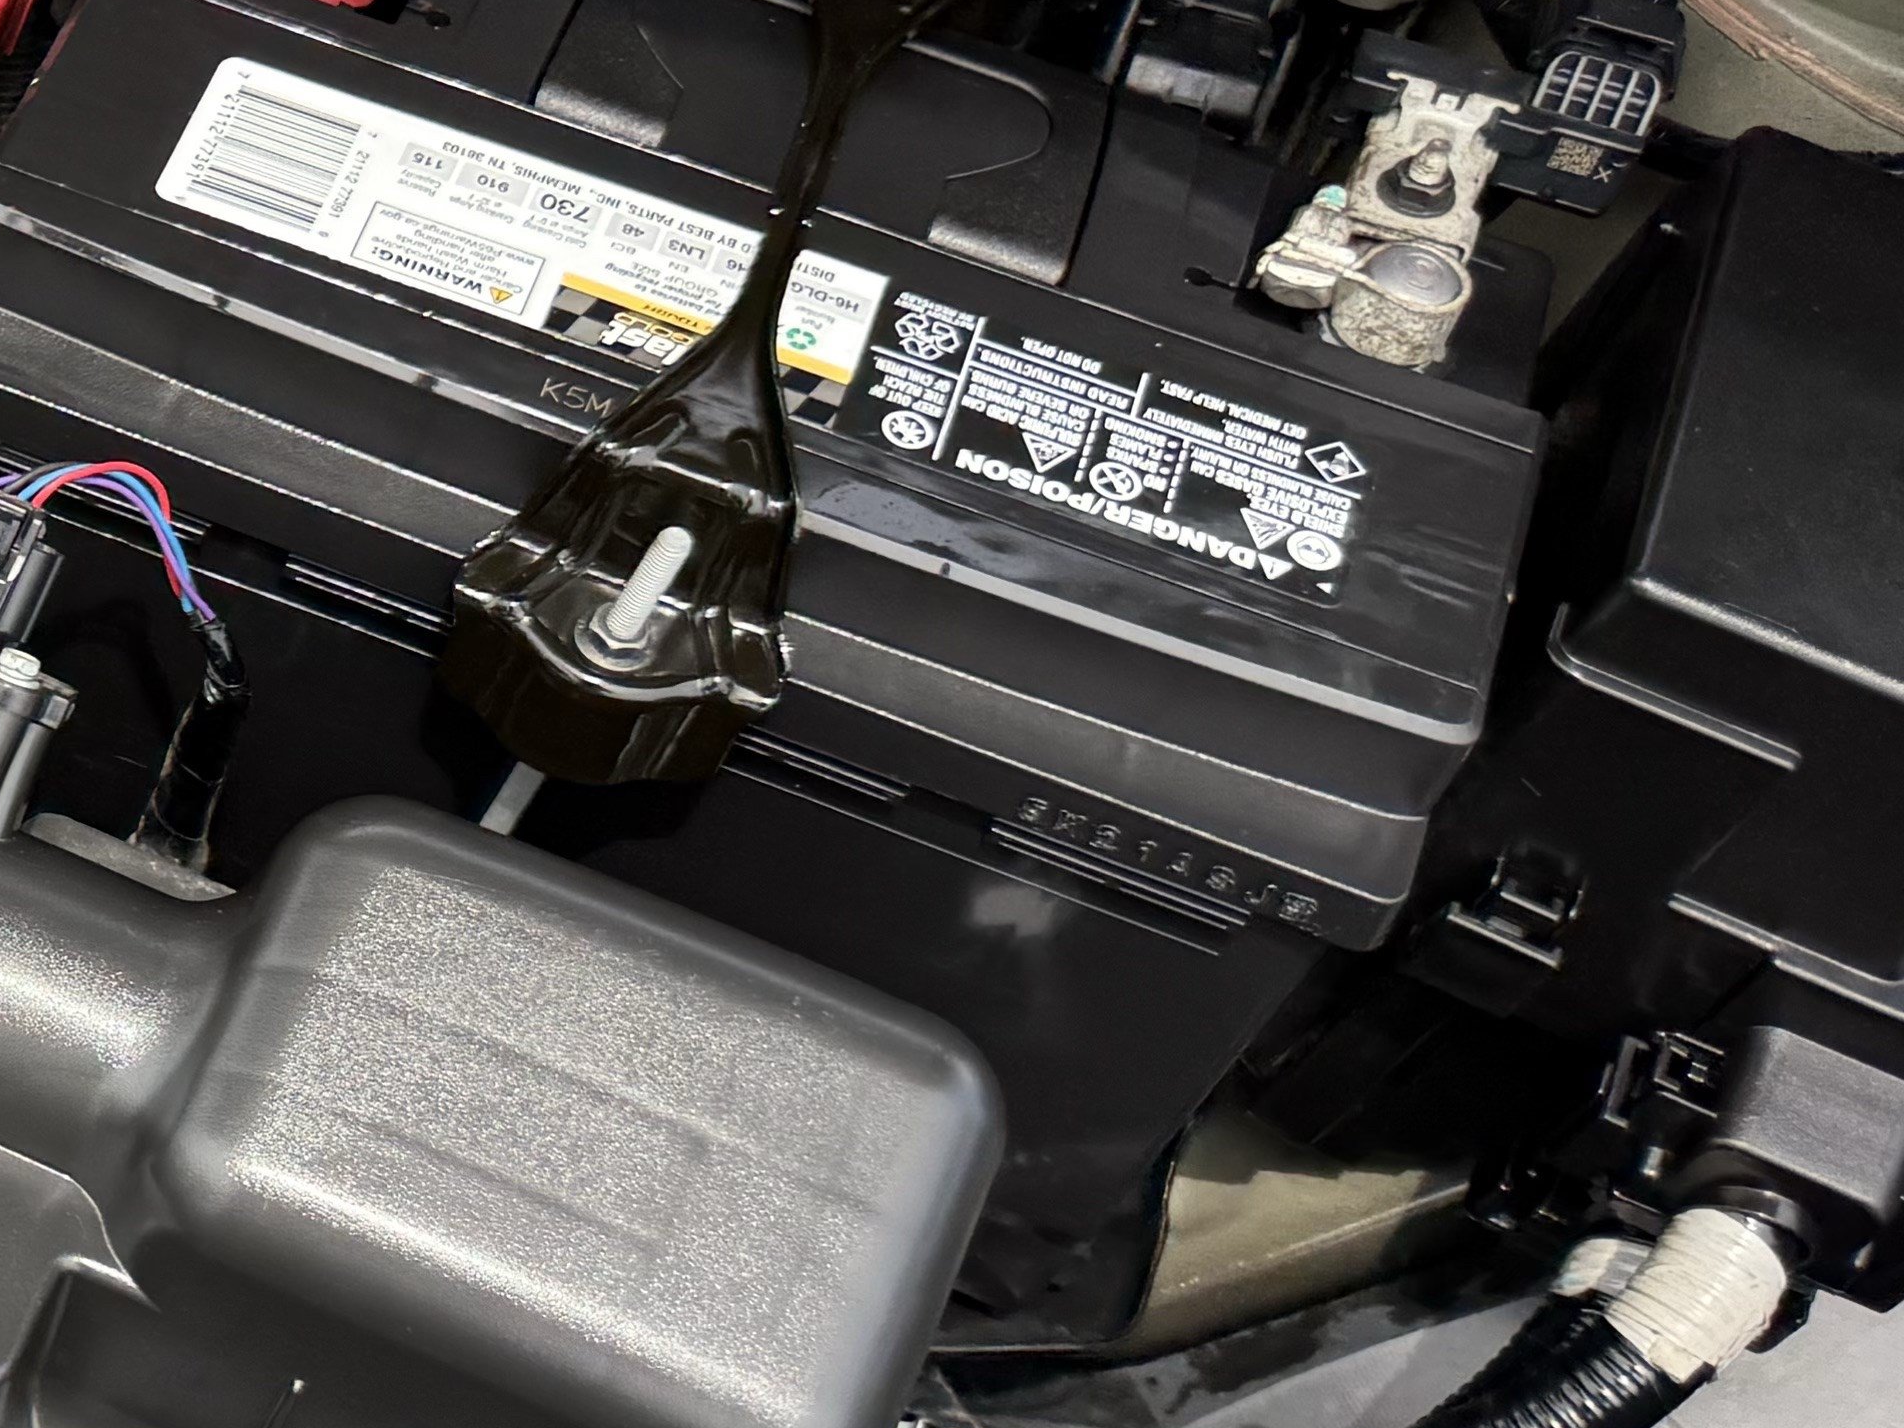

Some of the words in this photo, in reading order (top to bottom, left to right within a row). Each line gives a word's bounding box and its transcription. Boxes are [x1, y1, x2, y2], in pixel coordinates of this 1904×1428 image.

[344, 148, 369, 184] 21112
[411, 150, 444, 171] 115
[486, 156, 506, 171] TN
[396, 177, 436, 198] Reserve
[400, 167, 442, 189] Capacity
[476, 173, 510, 193] 910
[509, 163, 581, 196] MEMPHIS,
[448, 194, 473, 210] Amps
[473, 202, 514, 224] Cranking
[538, 191, 592, 223] 730
[623, 201, 674, 227] PARTS,
[521, 218, 563, 240] Cranking
[621, 223, 646, 239] 48
[677, 220, 714, 241] BEST
[370, 233, 451, 269] Reproductive
[395, 233, 432, 252] hands
[413, 228, 467, 254] handling
[562, 234, 587, 249] Cold
[667, 238, 706, 261] LN3
[716, 234, 737, 249] BY
[432, 245, 469, 264] Wash
[469, 249, 495, 263] after
[369, 245, 484, 294] WARNING:
[450, 263, 475, 278] and
[470, 259, 507, 277] Harm
[604, 260, 660, 288] recycling
[630, 261, 661, 279] SIZE
[668, 260, 689, 273] EN
[478, 272, 523, 294] Cancer
[634, 284, 647, 293] to
[661, 280, 703, 302] proper
[666, 273, 719, 298] GROUP
[649, 287, 702, 312] batteries
[789, 279, 859, 313] H6-DLG
[794, 303, 835, 323] Number
[800, 316, 822, 330] Part
[612, 309, 695, 347] GOLD
[1017, 335, 1058, 359] OPEN.
[1054, 348, 1083, 368] NOT
[973, 345, 1088, 396] INSTRUCTIONS.
[1080, 357, 1102, 375] DO
[868, 382, 887, 399] OF
[882, 374, 923, 397] REACH
[933, 377, 952, 394] OF
[965, 366, 1019, 395] BURNS.
[1158, 379, 1194, 402] FAST.
[885, 389, 912, 408] OUT
[922, 388, 947, 406] THE
[960, 394, 987, 412] CAN
[967, 381, 1042, 417] BLINDNESS
[1016, 384, 1069, 412] SEVERE
[1085, 384, 1131, 410] READ
[1191, 391, 1227, 413] HELP
[985, 403, 1019, 425] ACID
[1040, 407, 1086, 433] CAUSE
[1067, 402, 1090, 420] OR
[1225, 402, 1282, 432] MEDICAL
[1017, 413, 1083, 447] SULFURIC
[1103, 415, 1167, 447] SMOKING
[1142, 405, 1223, 444] IMMEDIATELY
[1219, 418, 1268, 445] WATER.
[1280, 421, 1306, 440] GET
[1108, 432, 1163, 460] FLAMES
[1223, 434, 1257, 455] EYES
[1266, 435, 1301, 456] WITH
[1104, 445, 1159, 473] SPARKS
[1187, 444, 1233, 470] INJURY.
[1231, 459, 1251, 477] OR
[1256, 445, 1298, 469] FLUSH
[1189, 460, 1216, 479] CAN
[1141, 472, 1168, 492] NO
[1213, 469, 1265, 497] GASES
[1249, 465, 1314, 498] BLINDNESS
[952, 447, 1260, 570] DANGER/POISON
[1243, 492, 1291, 520] EYES.
[1264, 486, 1349, 525] EXPLOSIVE
[1312, 487, 1352, 511] CAUSE
[1289, 508, 1346, 538] SHIELD
